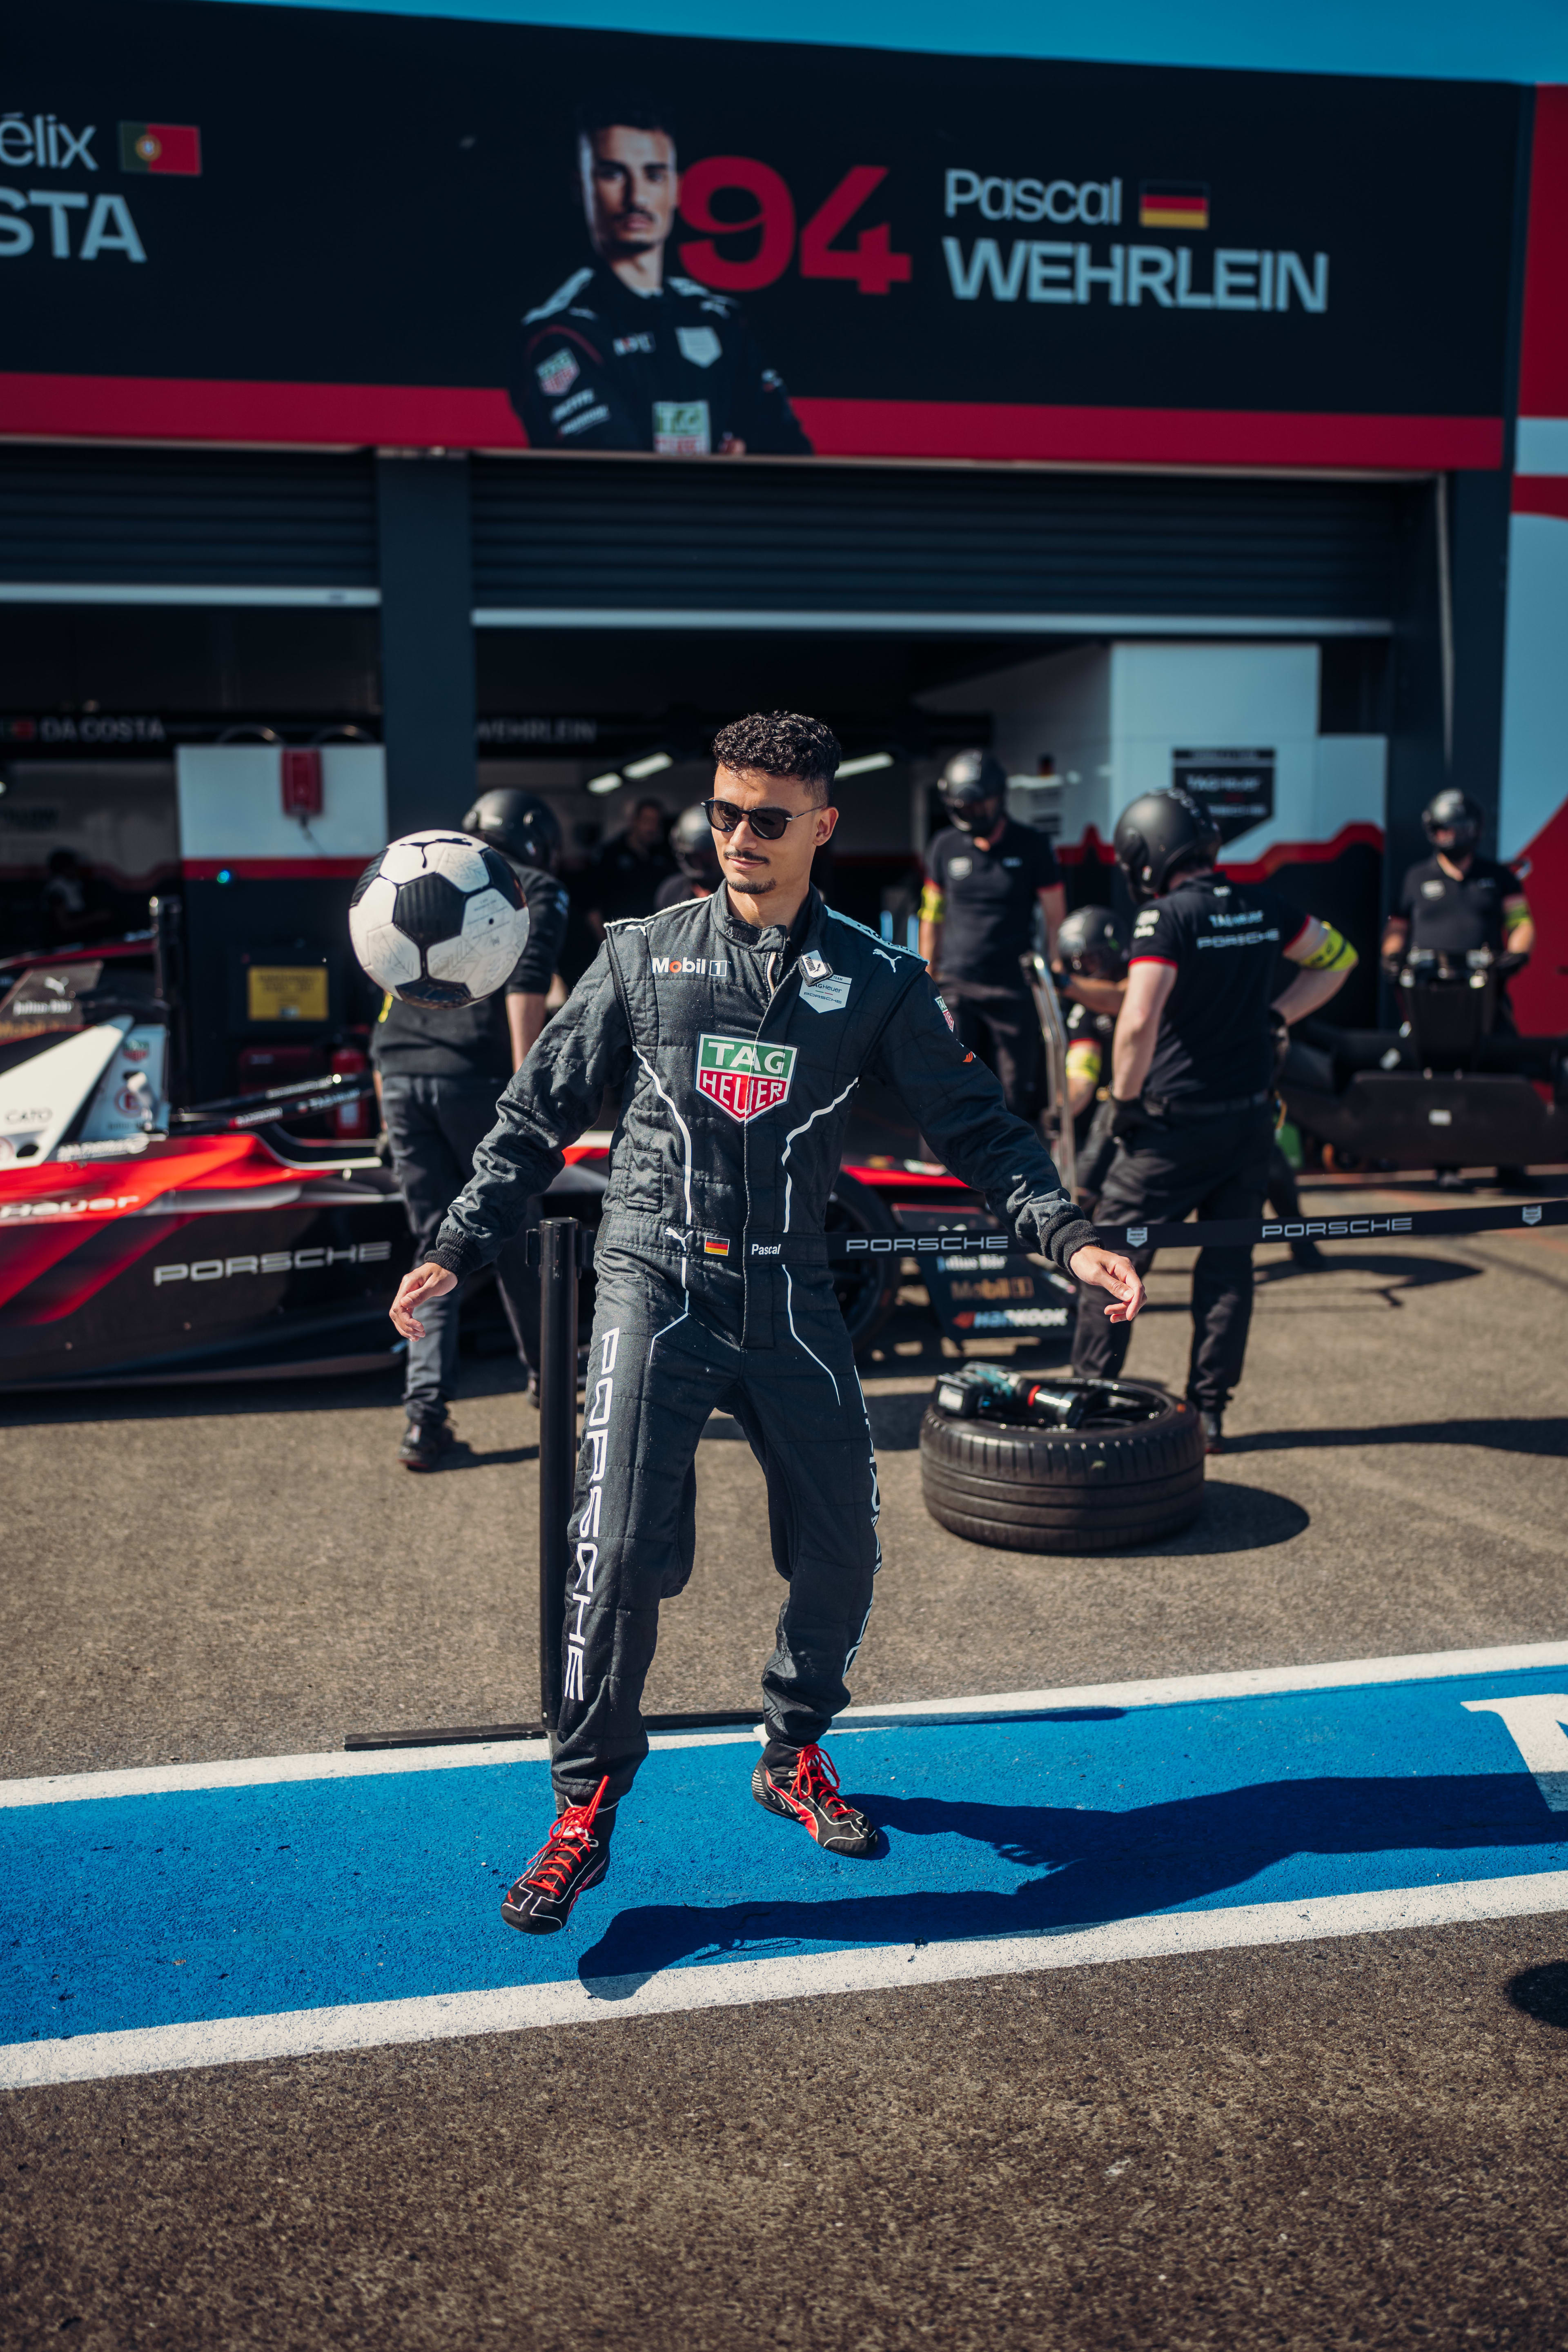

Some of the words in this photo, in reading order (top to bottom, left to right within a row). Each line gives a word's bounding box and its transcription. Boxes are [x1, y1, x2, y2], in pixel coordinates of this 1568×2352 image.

[944, 168, 1122, 225] Pascal
[676, 155, 911, 295] 94
[942, 236, 1329, 313] WEHRLEIN
[652, 957, 706, 974] Mobil
[804, 956, 816, 971] PUMA
[804, 992, 842, 1004] PORSCHE
[813, 983, 842, 993] AGHeuer
[708, 1041, 786, 1074] TAG
[702, 1073, 782, 1114] HEUER
[1263, 1217, 1412, 1238] PORSCHE
[751, 1243, 782, 1256] Pascal
[846, 1236, 1008, 1252] PORSCHE
[154, 1241, 392, 1286] PORSCHE
[564, 1327, 620, 1702] PORSCHE
